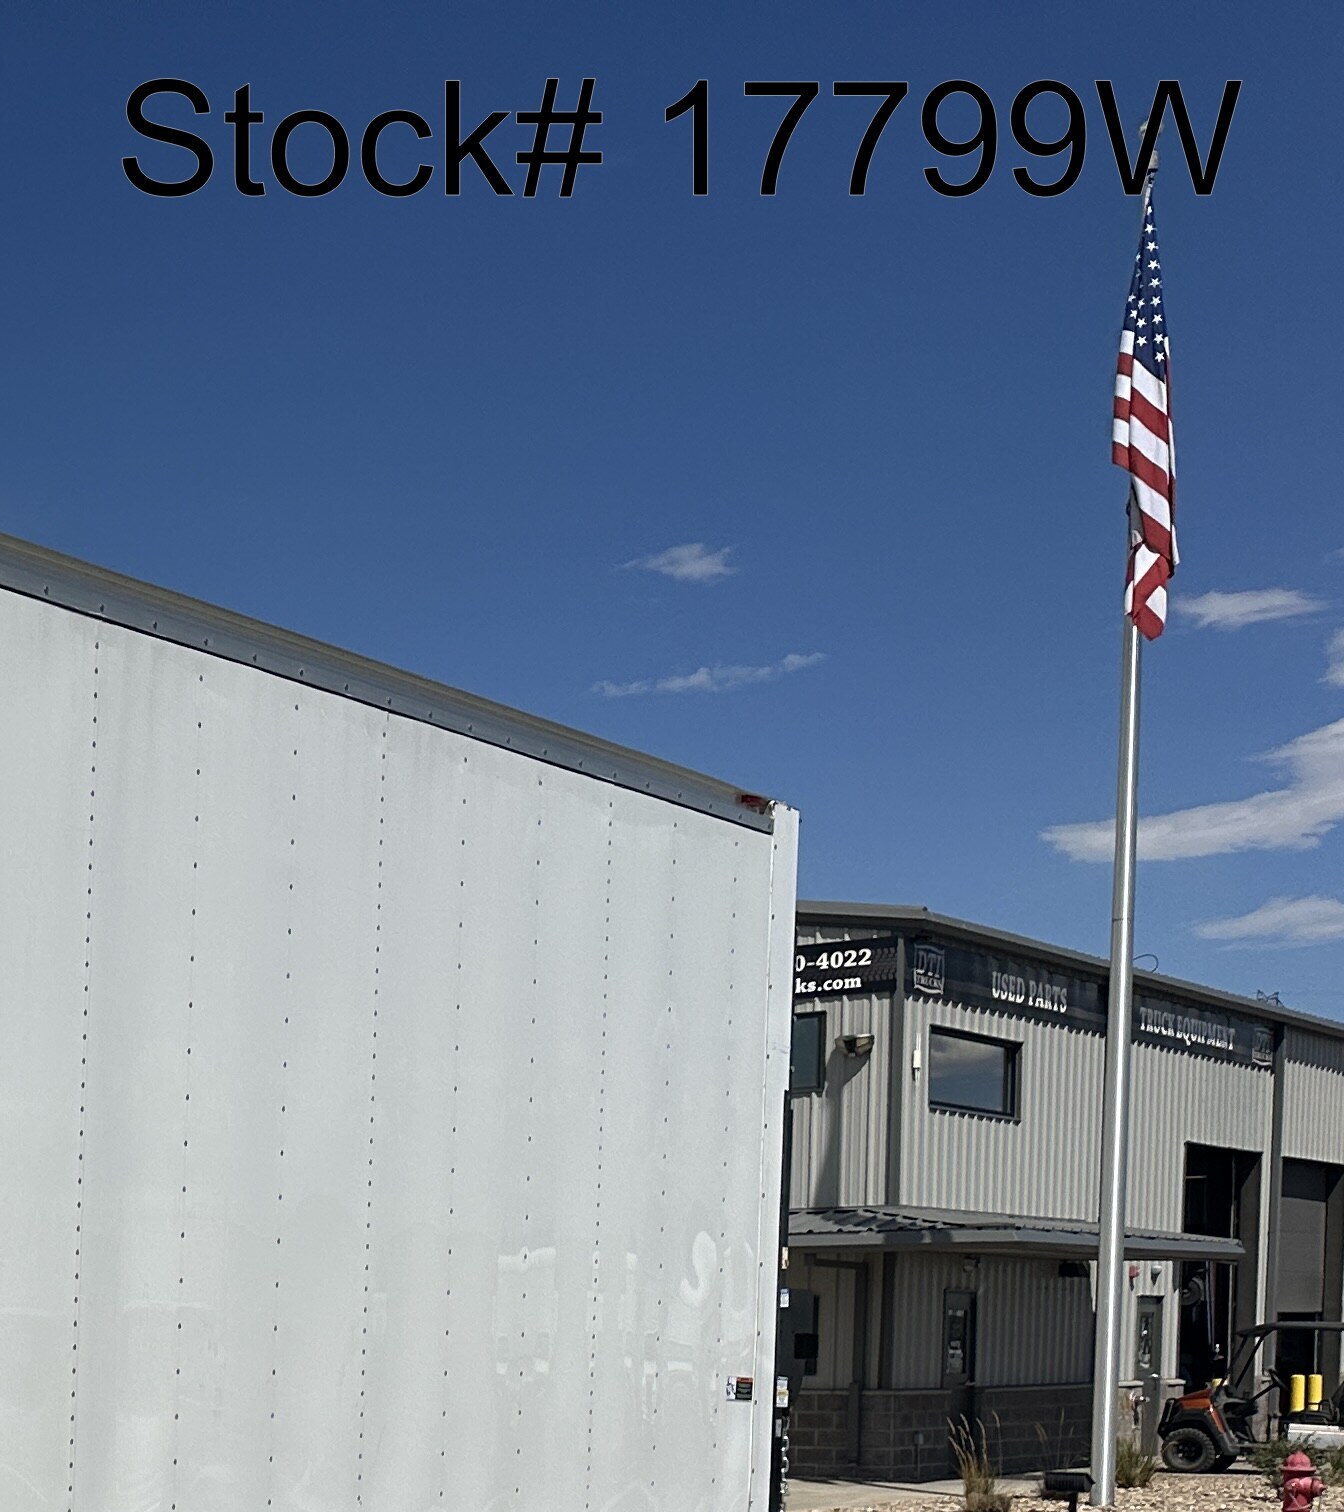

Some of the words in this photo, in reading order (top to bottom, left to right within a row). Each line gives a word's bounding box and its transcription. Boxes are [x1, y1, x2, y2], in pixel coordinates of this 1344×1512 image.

[916, 951, 943, 978] DTI
[992, 971, 1025, 1004] USED
[1028, 980, 1068, 1013] PARTS
[1139, 1007, 1175, 1036] TRUCK
[1176, 1015, 1235, 1051] EQUIPMENT
